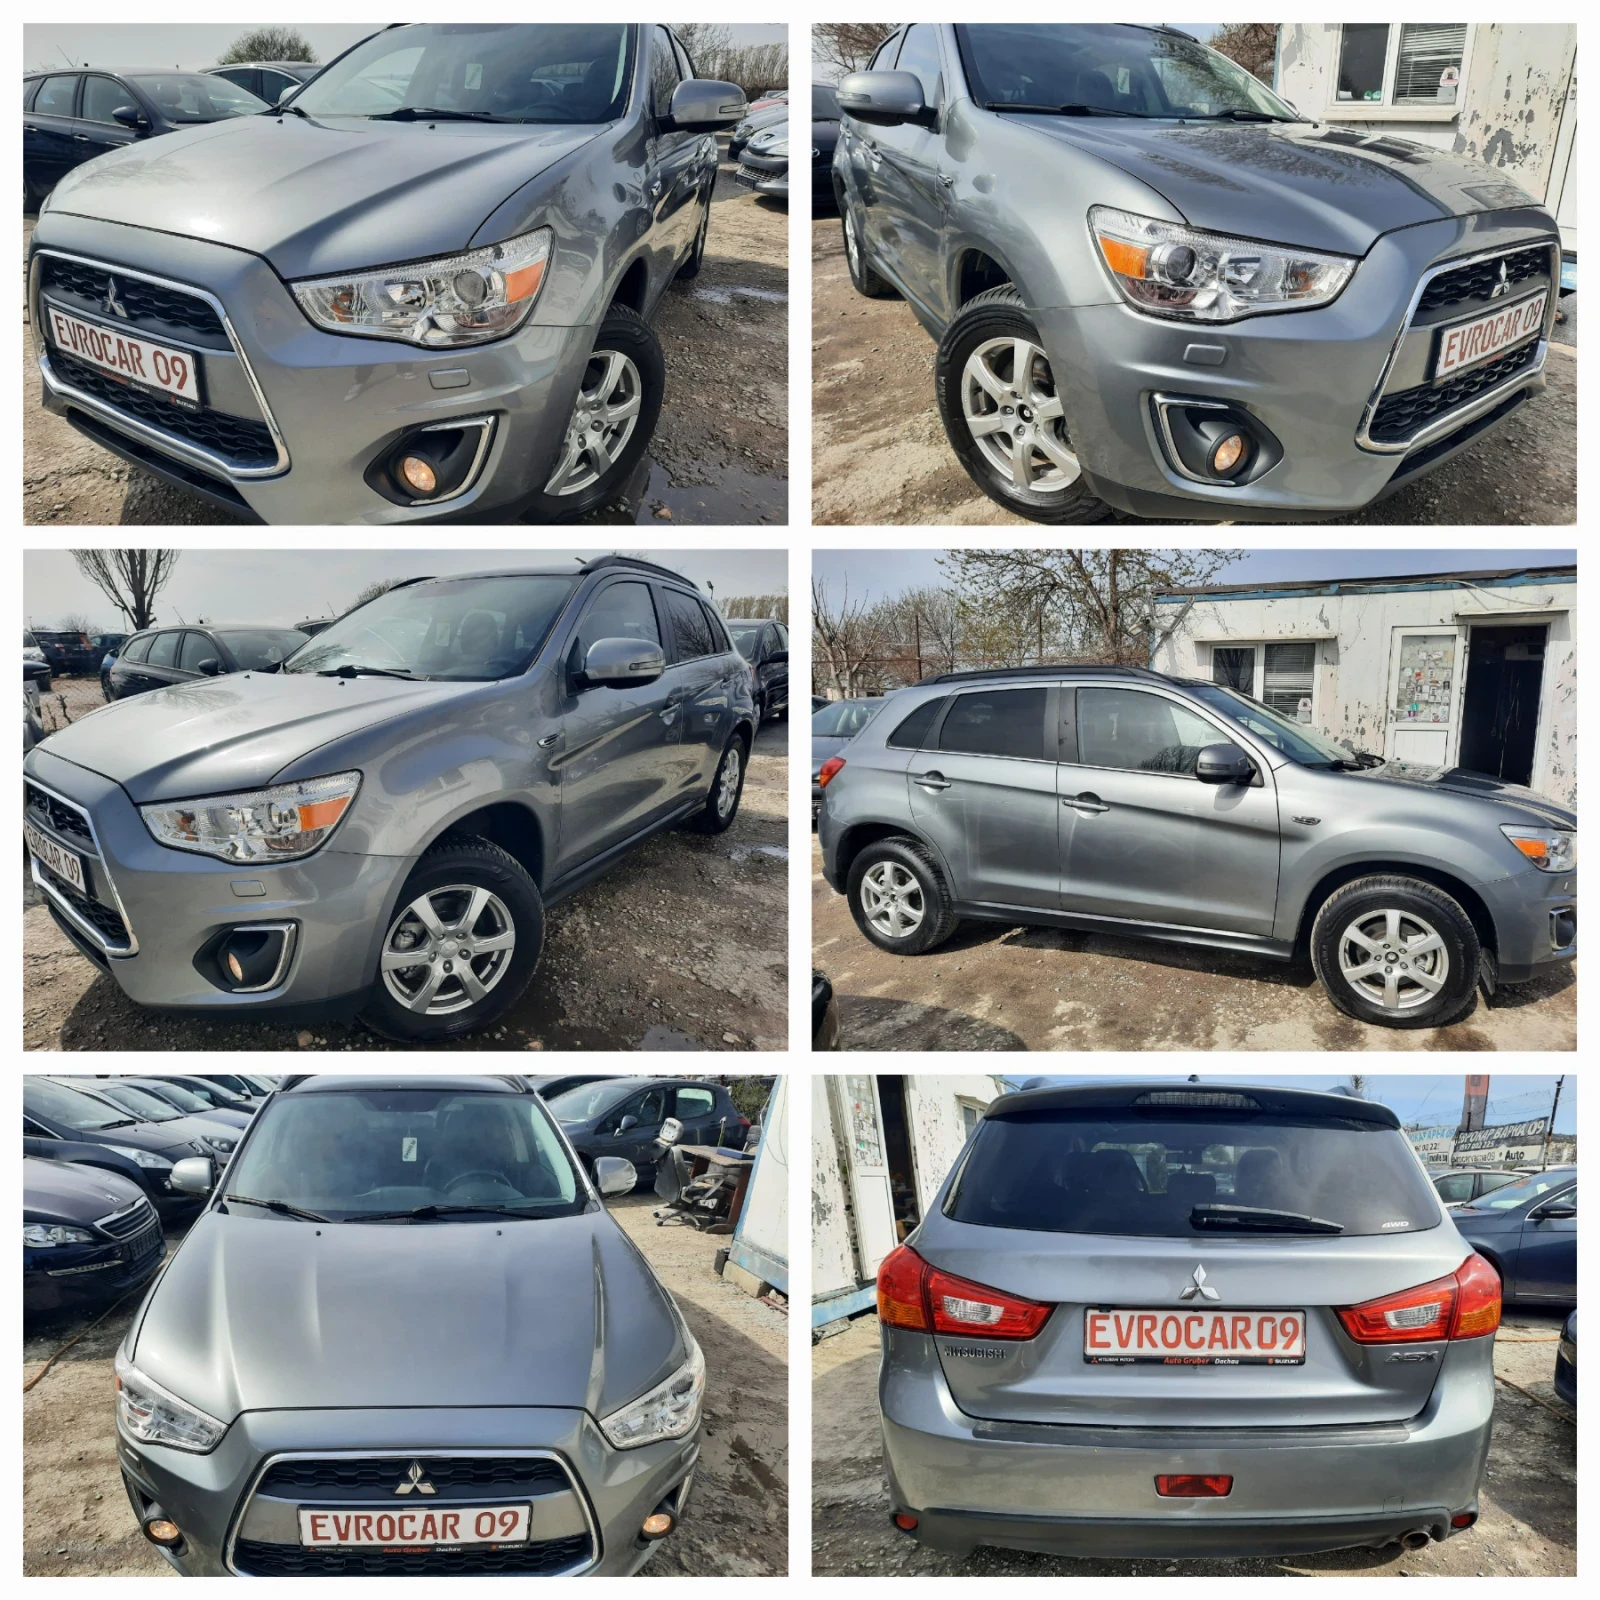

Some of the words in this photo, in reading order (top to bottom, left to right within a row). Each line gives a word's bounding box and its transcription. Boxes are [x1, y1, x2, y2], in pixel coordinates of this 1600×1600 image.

[1443, 308, 1523, 369] EVROCAR
[1523, 298, 1543, 332] 09
[54, 314, 147, 378] EVROCAR
[153, 350, 188, 390] 09
[64, 853, 80, 885] 09
[1493, 1123, 1528, 1139] ВАРНА
[1528, 1119, 1545, 1135] 09
[1505, 1149, 1525, 1161] Auto
[1089, 1314, 1253, 1350] EVROCAR
[1257, 1316, 1300, 1351] 09
[944, 1345, 1008, 1359] MITSUBISHI
[1163, 1356, 1182, 1364] Auto
[1183, 1356, 1210, 1365] Gruber
[1214, 1357, 1240, 1365] Dachau
[1385, 1351, 1439, 1362] ASX
[309, 1513, 461, 1542] EVROCAR
[474, 1510, 520, 1539] 09
